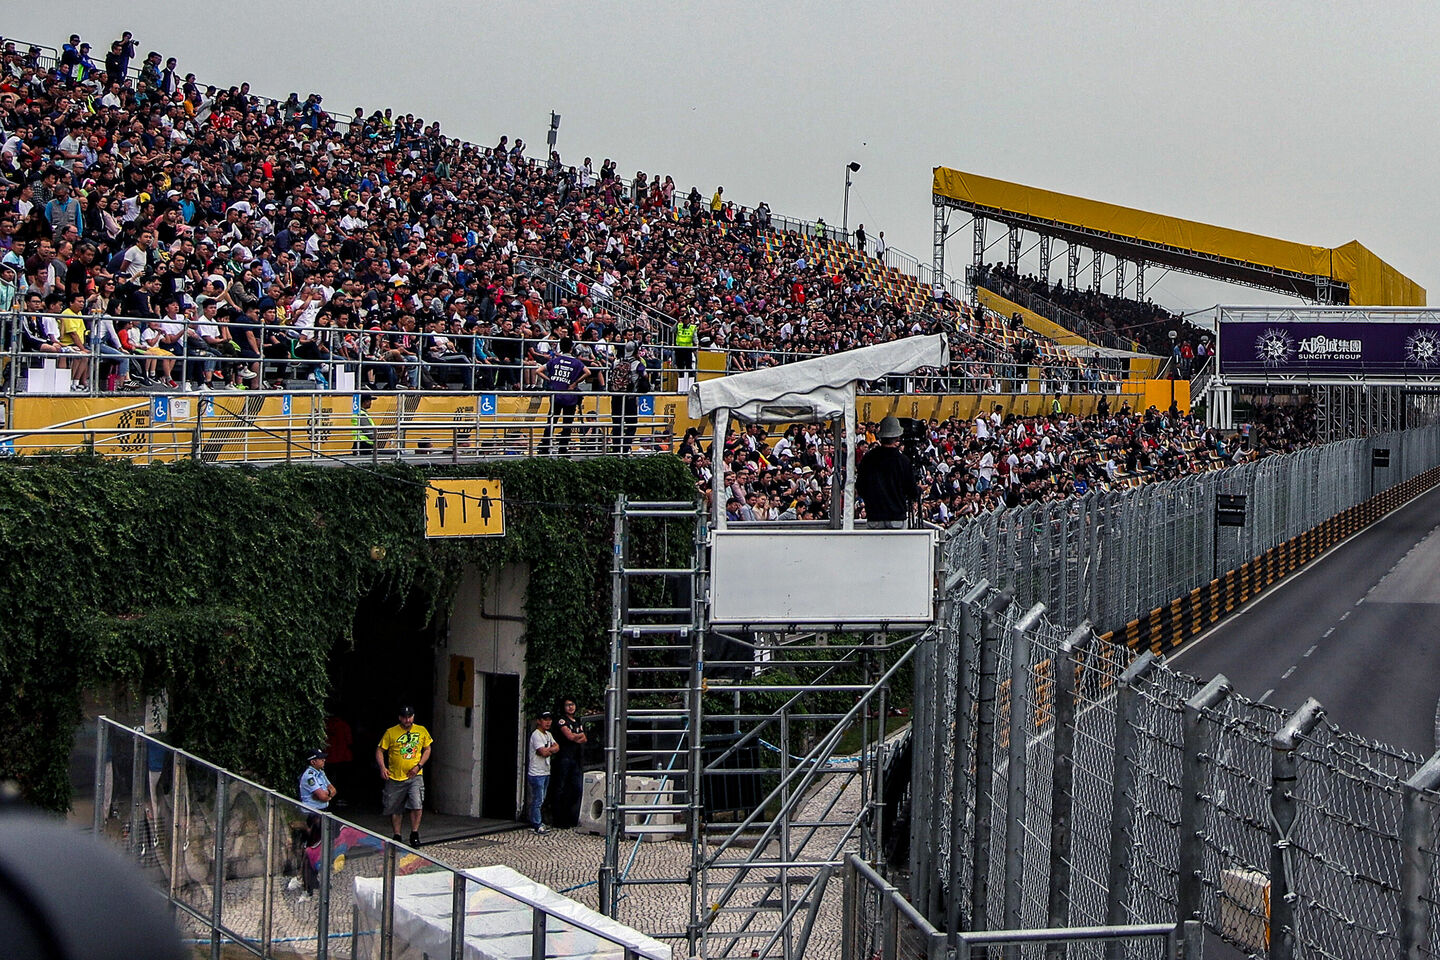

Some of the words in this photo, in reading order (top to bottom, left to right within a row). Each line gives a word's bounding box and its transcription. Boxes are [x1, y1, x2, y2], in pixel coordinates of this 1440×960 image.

[1298, 335, 1362, 355] 太陽城集團
